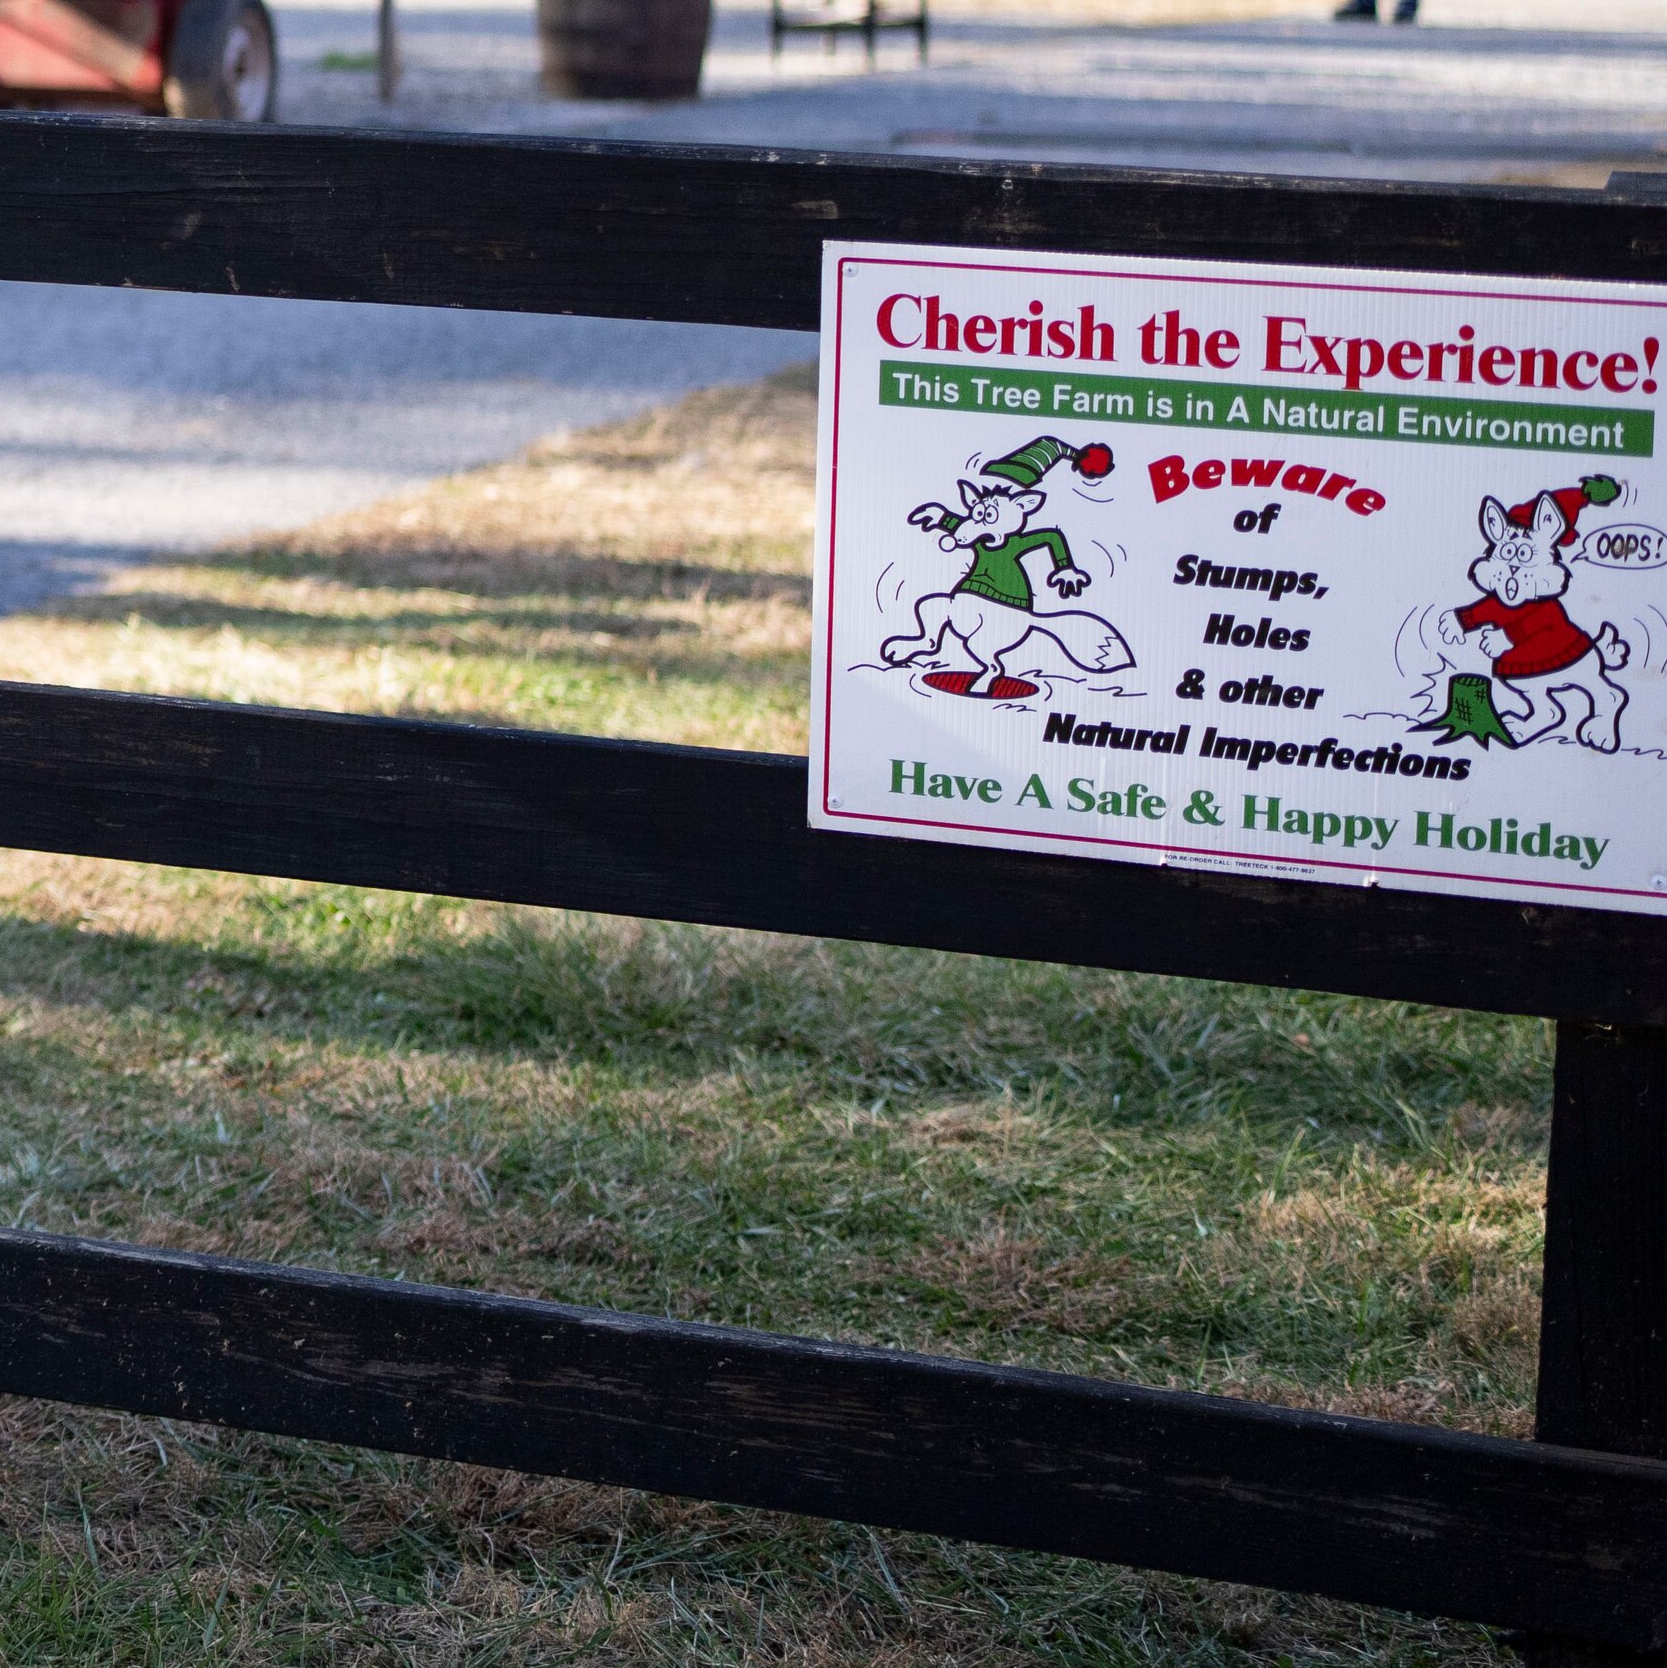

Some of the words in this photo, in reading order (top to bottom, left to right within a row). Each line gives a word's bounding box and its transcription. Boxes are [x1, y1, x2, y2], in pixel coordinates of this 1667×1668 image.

[877, 294, 1115, 361] Cherish
[1138, 310, 1239, 369] the
[1263, 316, 1659, 394] Experience!
[893, 373, 959, 402] This
[971, 379, 1040, 408] Tree
[1054, 385, 1133, 415] Farm
[1148, 391, 1173, 418] is
[1187, 393, 1213, 420] in
[1227, 397, 1249, 423] A
[1263, 398, 1384, 432] Natural
[1399, 408, 1624, 449] Environment
[1148, 455, 1386, 516] Beware
[1234, 503, 1281, 533] of
[1597, 533, 1663, 561] OOPS!
[1174, 555, 1329, 601] Stumps,
[1203, 614, 1310, 651] Holes
[1176, 669, 1205, 699] &
[1219, 675, 1324, 709] other
[1043, 713, 1191, 754] Natural
[1199, 727, 1471, 780] Imperfections
[889, 760, 1002, 803] Have
[1015, 774, 1053, 809] A
[1068, 778, 1166, 820] Safe
[1183, 790, 1225, 826] &
[1242, 795, 1399, 850] Happy
[1415, 811, 1609, 870] Holiday
